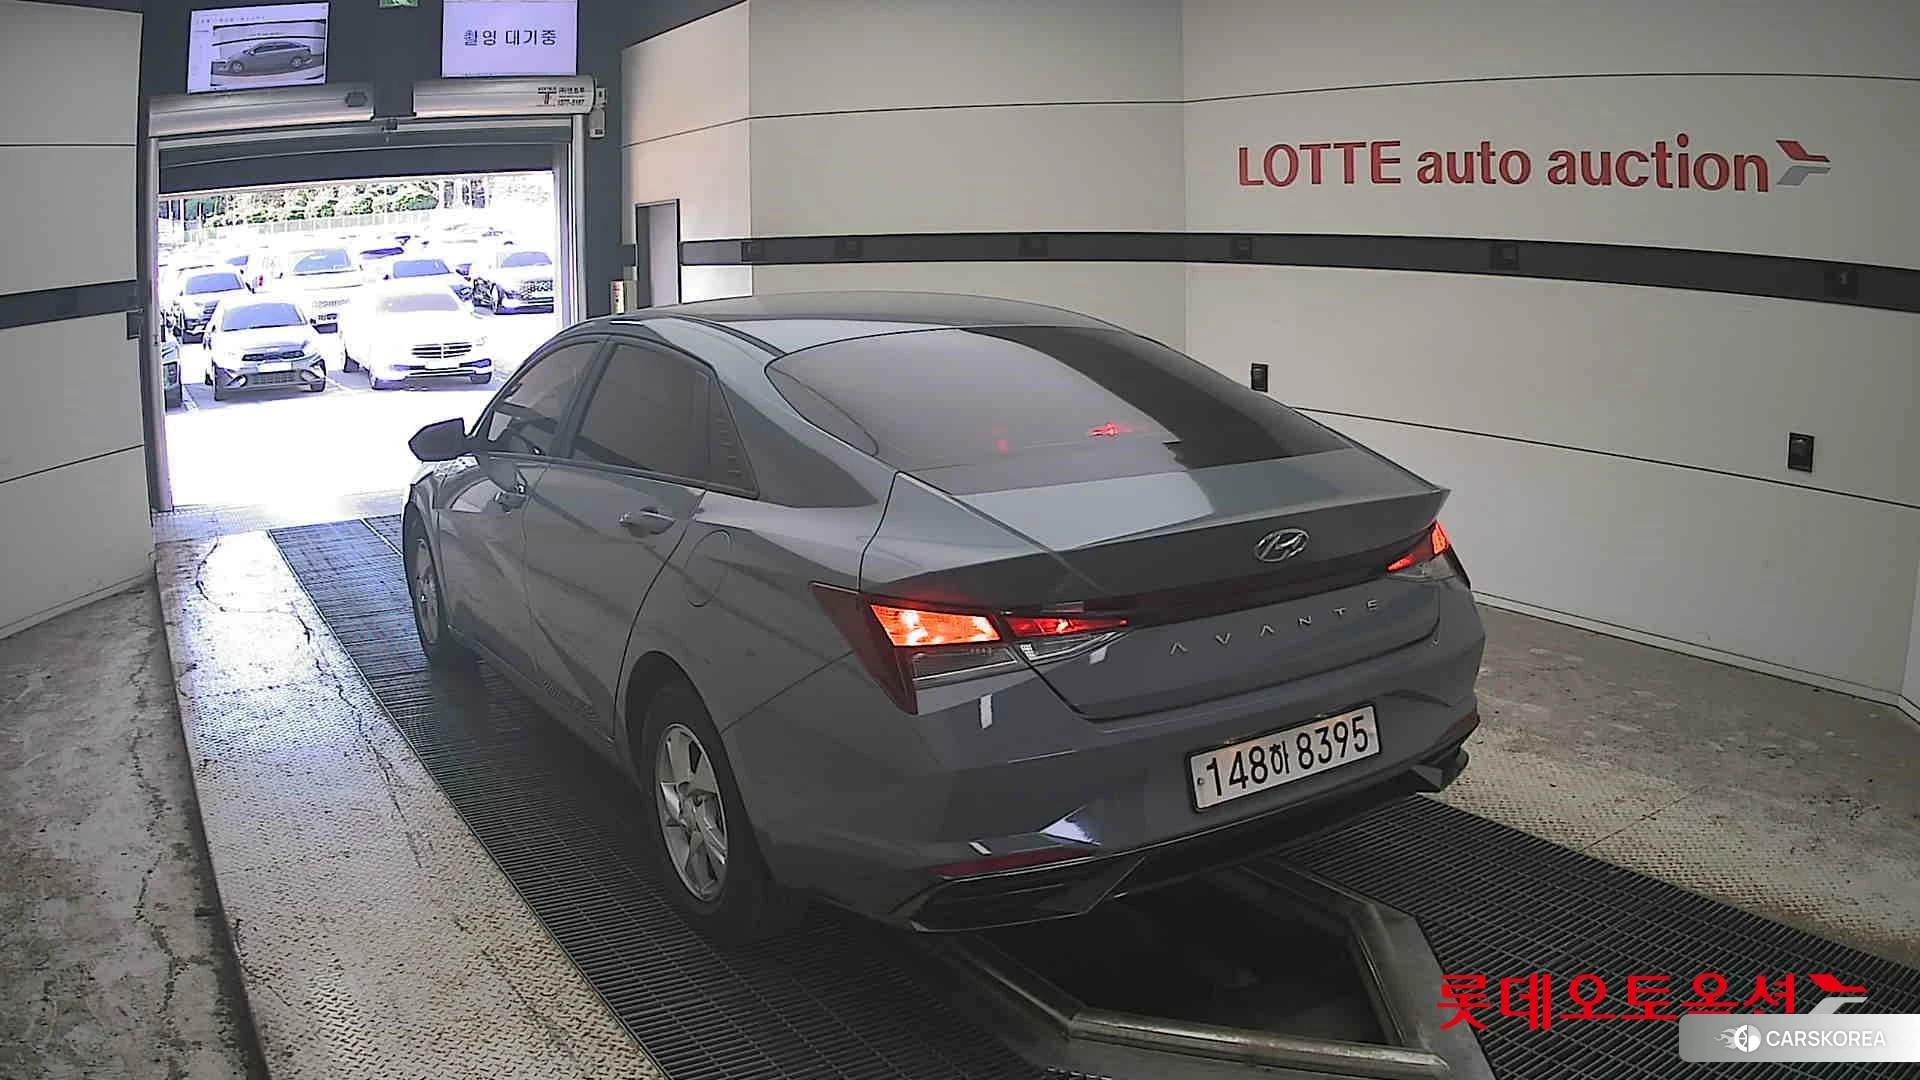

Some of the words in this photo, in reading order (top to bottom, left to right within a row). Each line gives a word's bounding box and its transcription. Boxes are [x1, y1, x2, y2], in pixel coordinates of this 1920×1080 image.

[505, 29, 557, 46] 대기중
[1239, 140, 1402, 187] LOTTE
[1417, 141, 1532, 185] auto
[1547, 133, 1769, 193] auction
[1169, 598, 1381, 656] AVANTE
[1206, 740, 1291, 797] 148하
[1295, 715, 1369, 770] 8395
